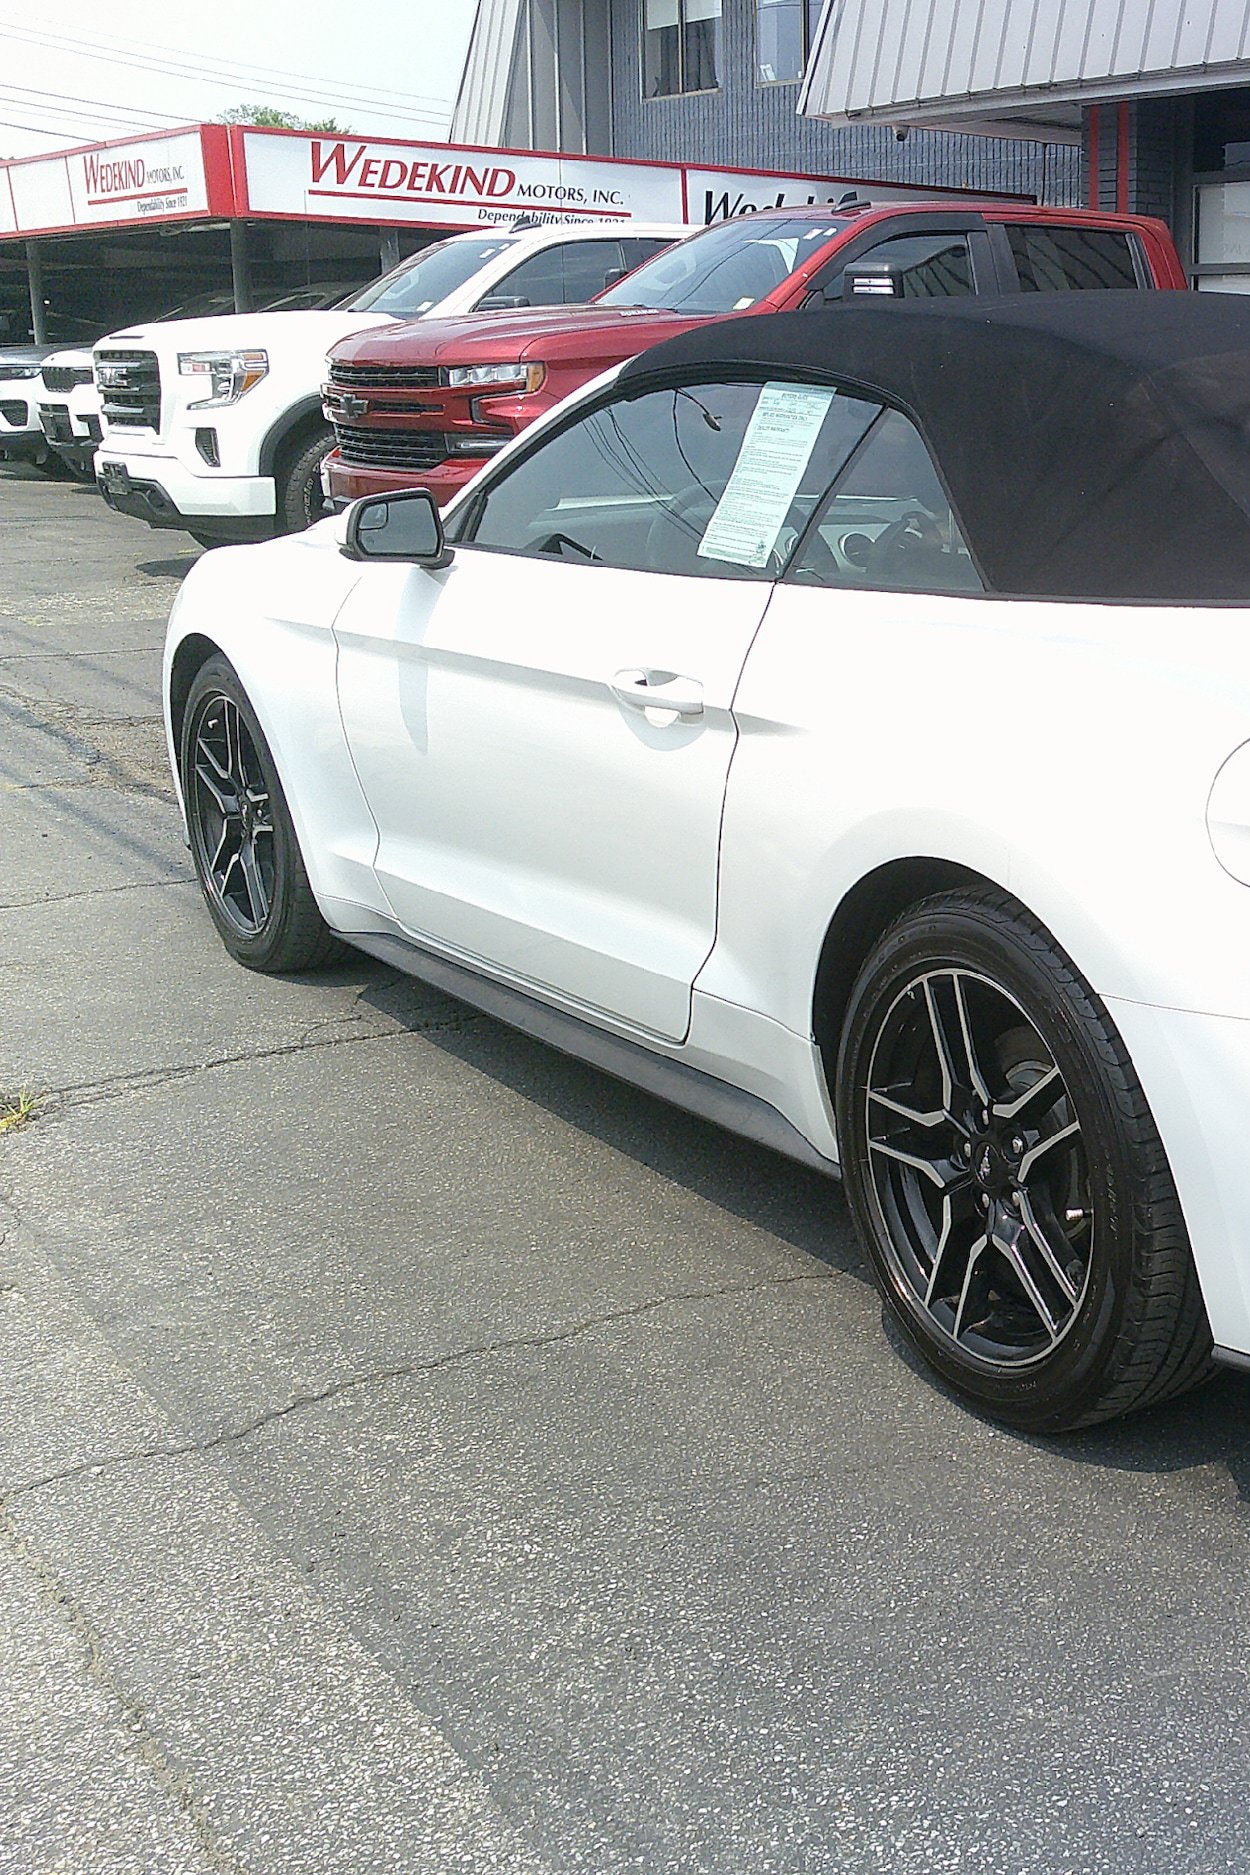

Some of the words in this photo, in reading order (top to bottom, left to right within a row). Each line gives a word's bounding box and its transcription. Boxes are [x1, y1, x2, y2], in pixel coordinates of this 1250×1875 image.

[83, 153, 145, 194] WEDEKIND
[311, 141, 516, 198] WEDEKIND
[517, 184, 588, 204] MOTORS,
[593, 189, 624, 205] INC.
[478, 208, 563, 224] Dependbility
